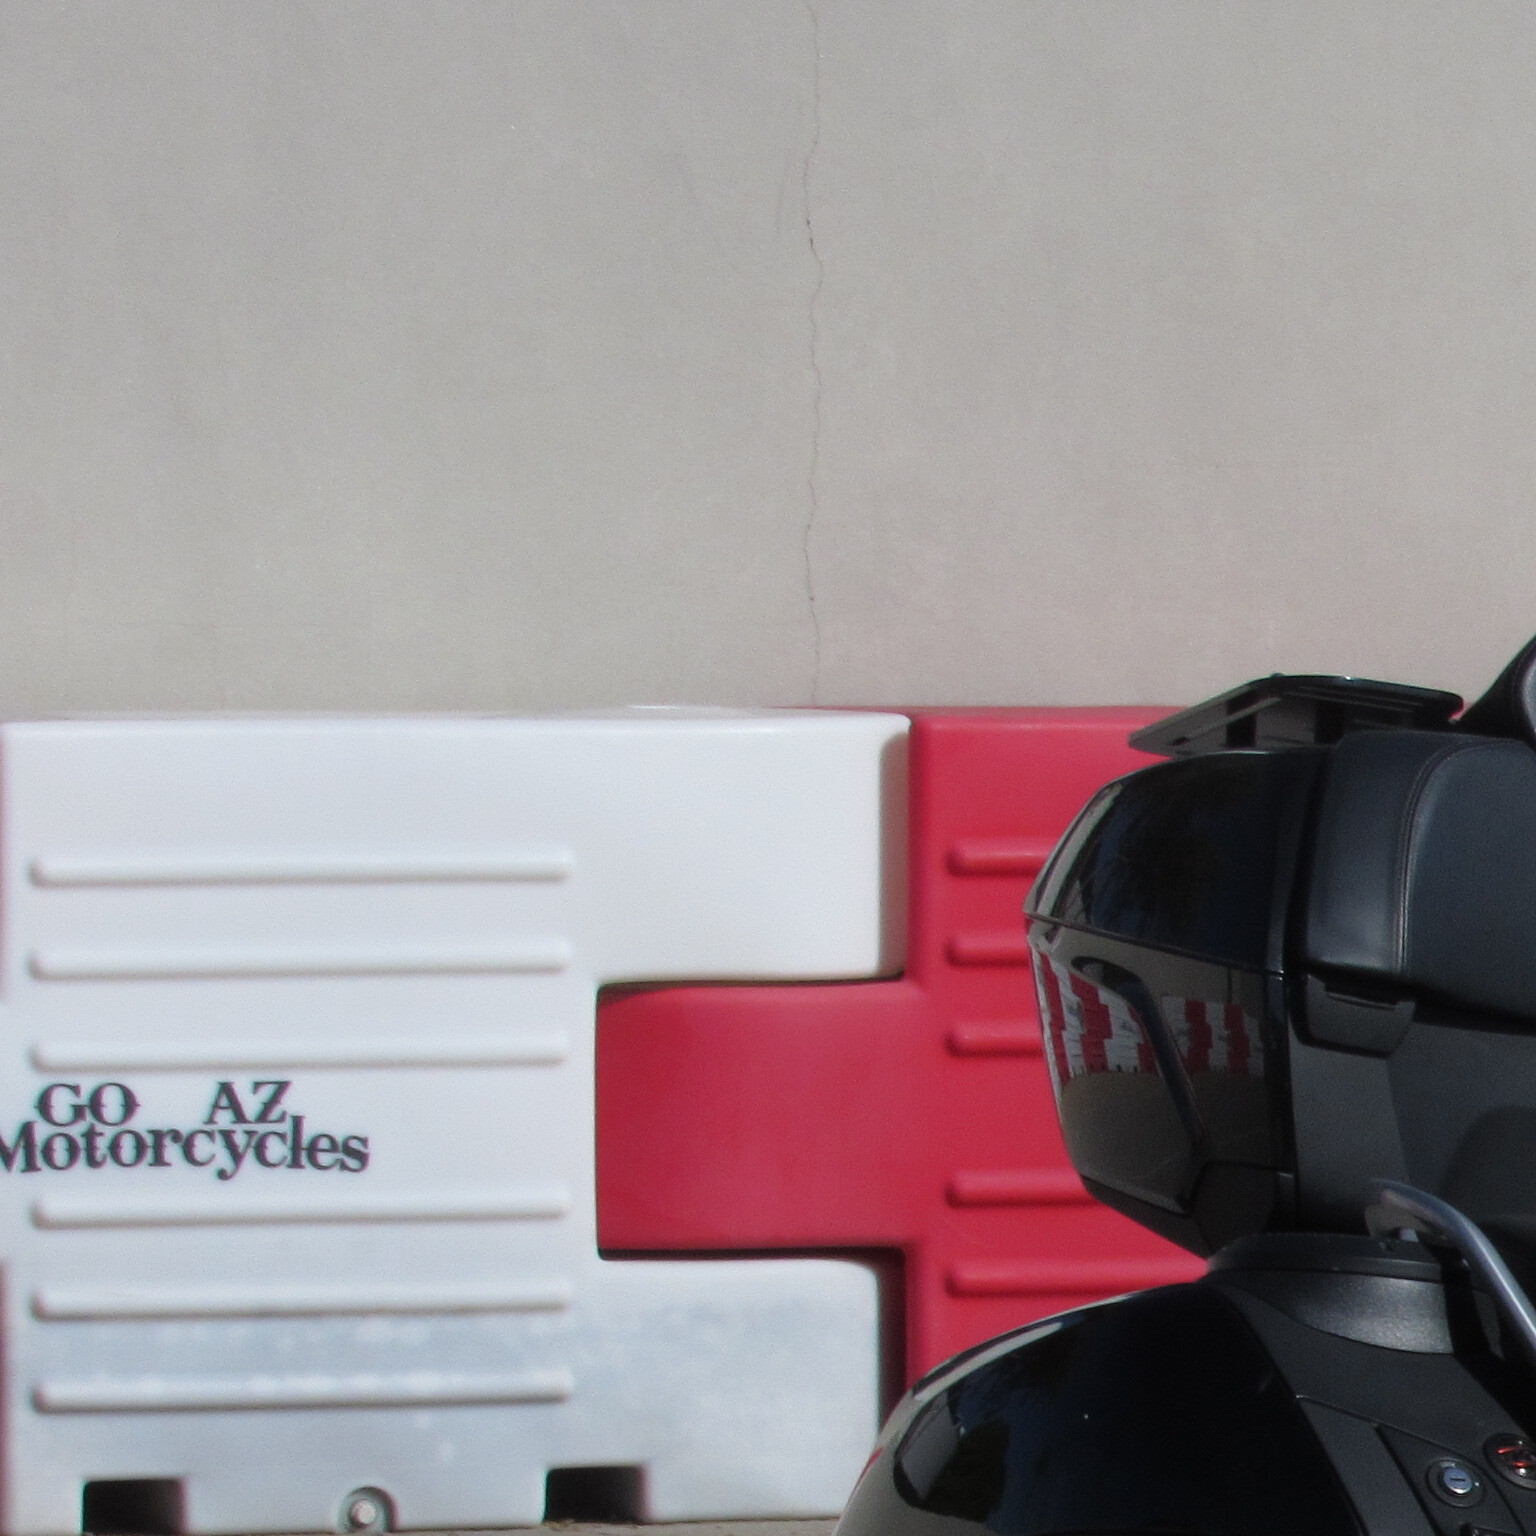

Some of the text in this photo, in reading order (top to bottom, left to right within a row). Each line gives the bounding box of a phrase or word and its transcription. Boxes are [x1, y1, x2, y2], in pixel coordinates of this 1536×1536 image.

[34, 1080, 292, 1127] GO AZ
[0, 1115, 371, 1181] Motorcycles
